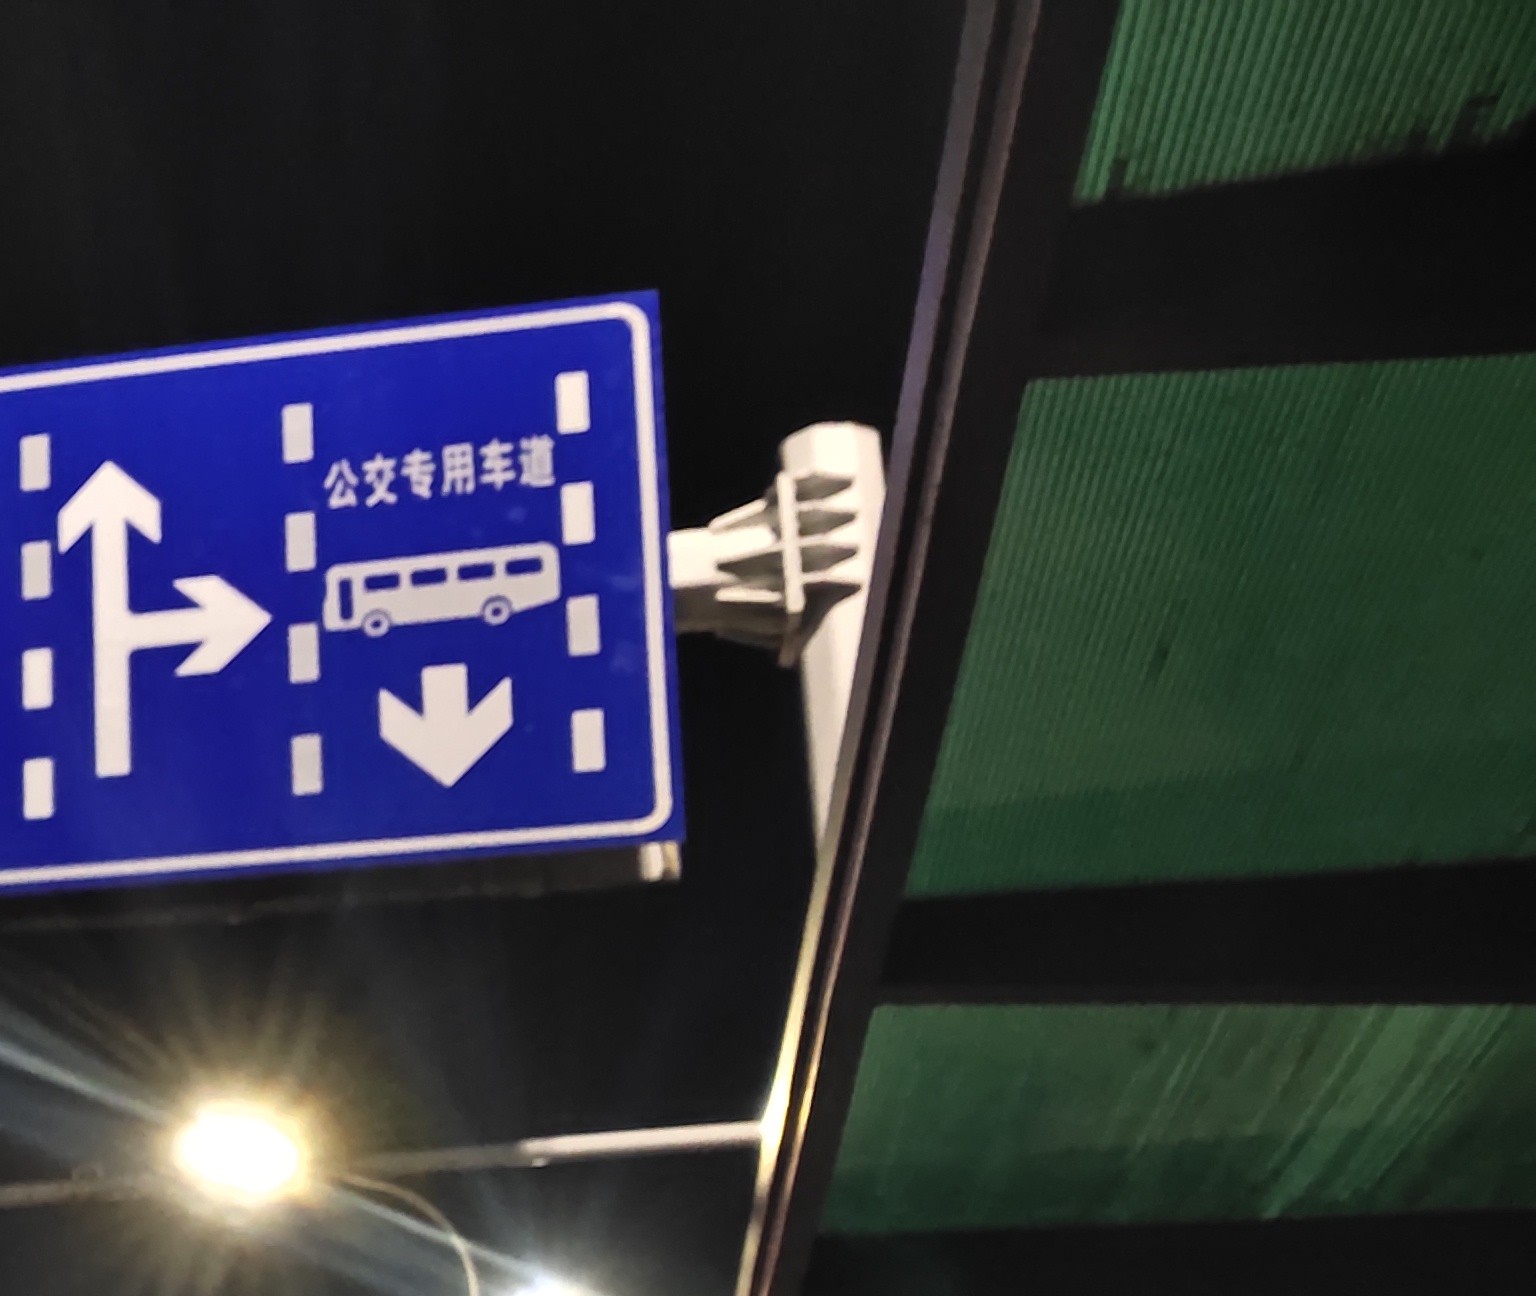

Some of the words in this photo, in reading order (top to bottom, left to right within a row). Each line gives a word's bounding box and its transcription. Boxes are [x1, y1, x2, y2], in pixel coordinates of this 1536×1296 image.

[323, 434, 556, 510] 公交专用车道
